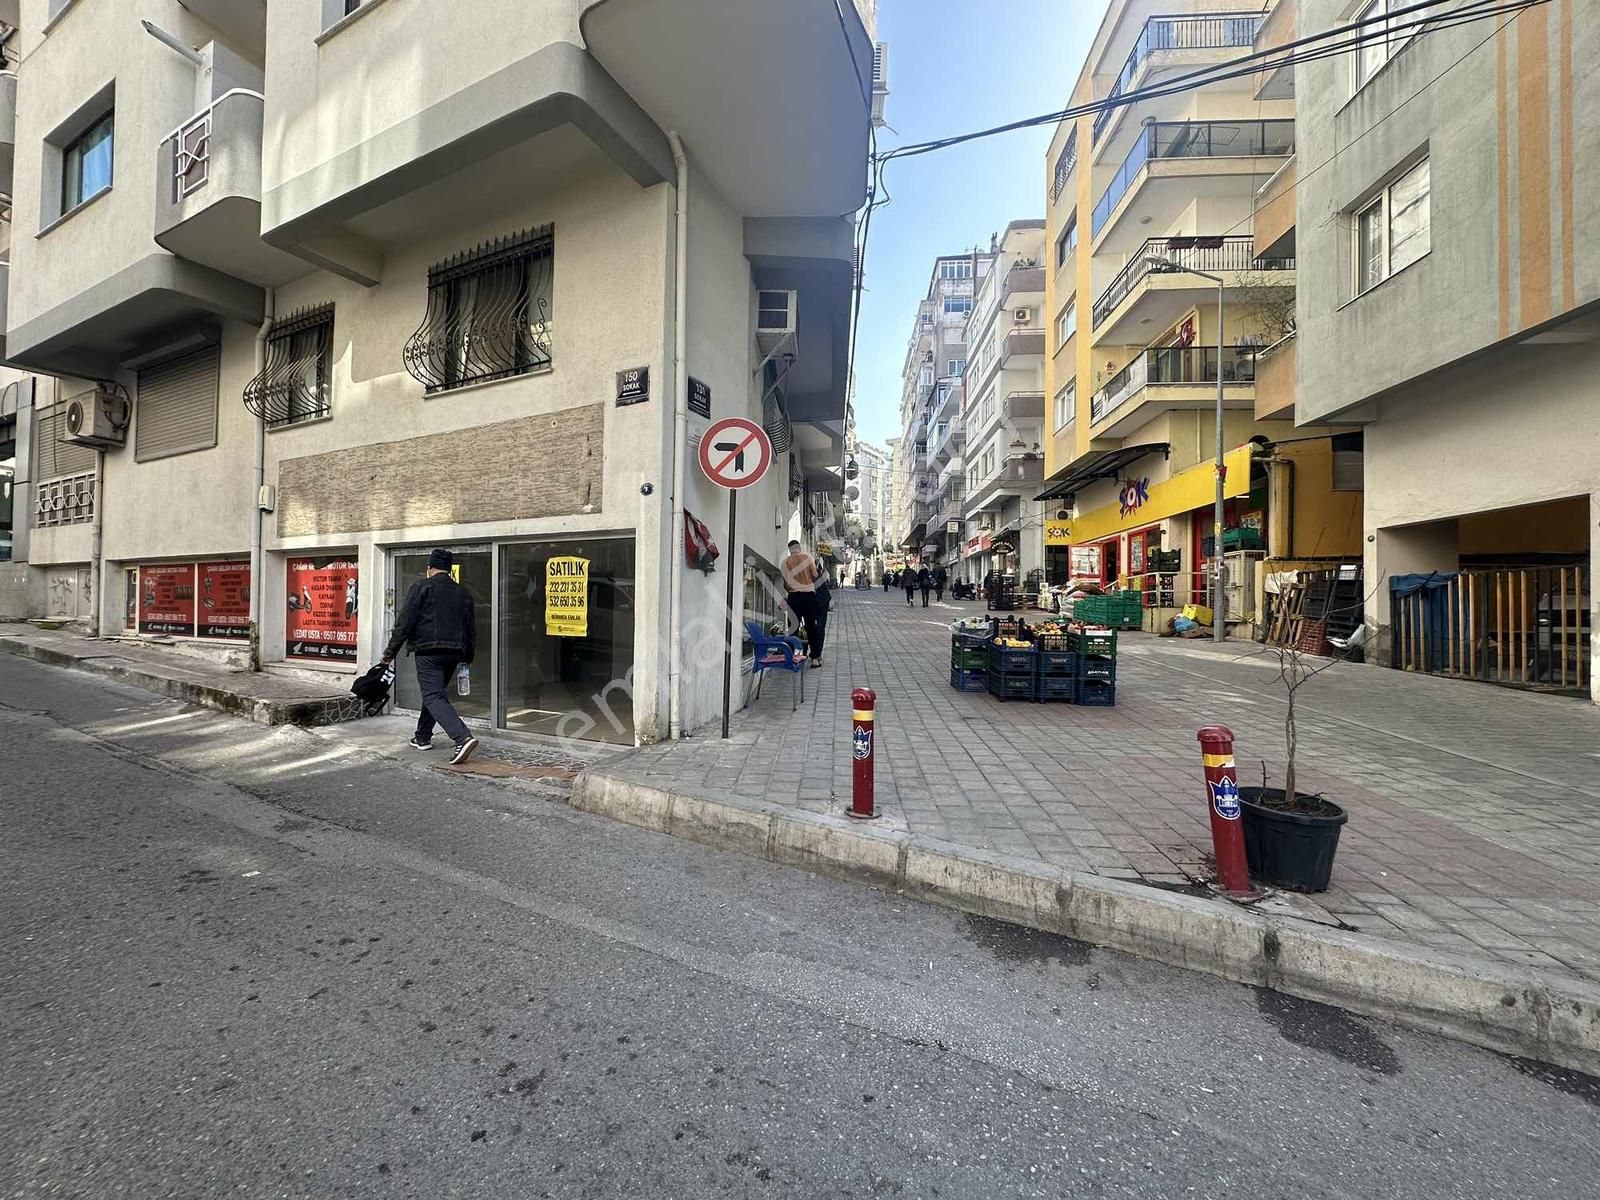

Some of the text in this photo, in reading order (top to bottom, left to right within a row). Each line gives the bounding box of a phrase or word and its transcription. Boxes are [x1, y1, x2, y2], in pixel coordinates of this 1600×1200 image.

[625, 371, 638, 382] 150
[622, 382, 640, 391] SOKAK
[549, 561, 585, 576] SATILIK
[549, 581, 584, 593] 232 231 35 31
[549, 595, 585, 608] 532 650 35 96
